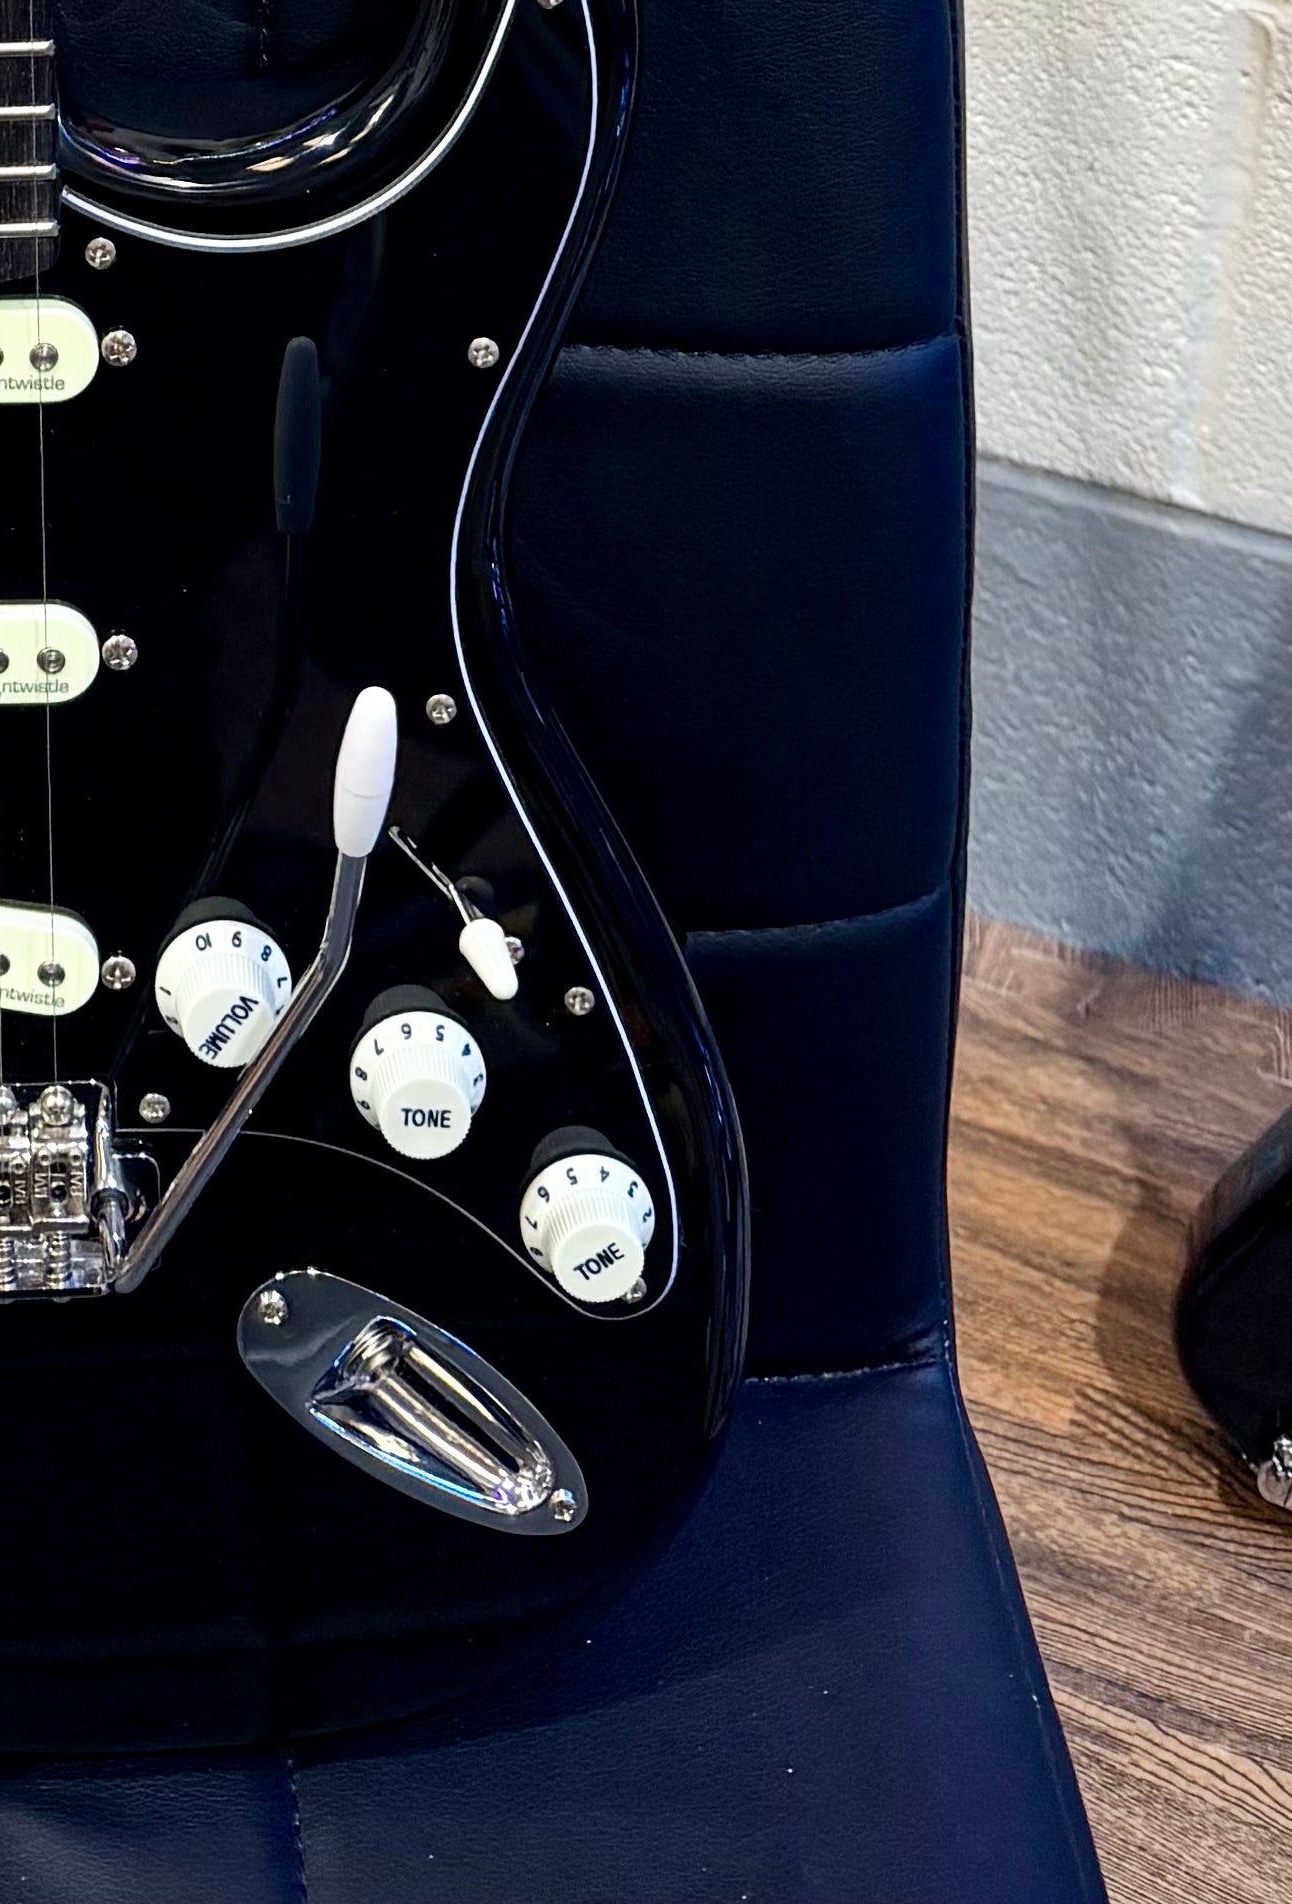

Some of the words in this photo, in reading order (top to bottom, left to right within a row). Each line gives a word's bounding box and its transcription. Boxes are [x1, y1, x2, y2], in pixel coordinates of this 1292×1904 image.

[198, 995, 259, 1060] VOLUME
[400, 1108, 452, 1128] TONE
[573, 1242, 625, 1281] TONE
